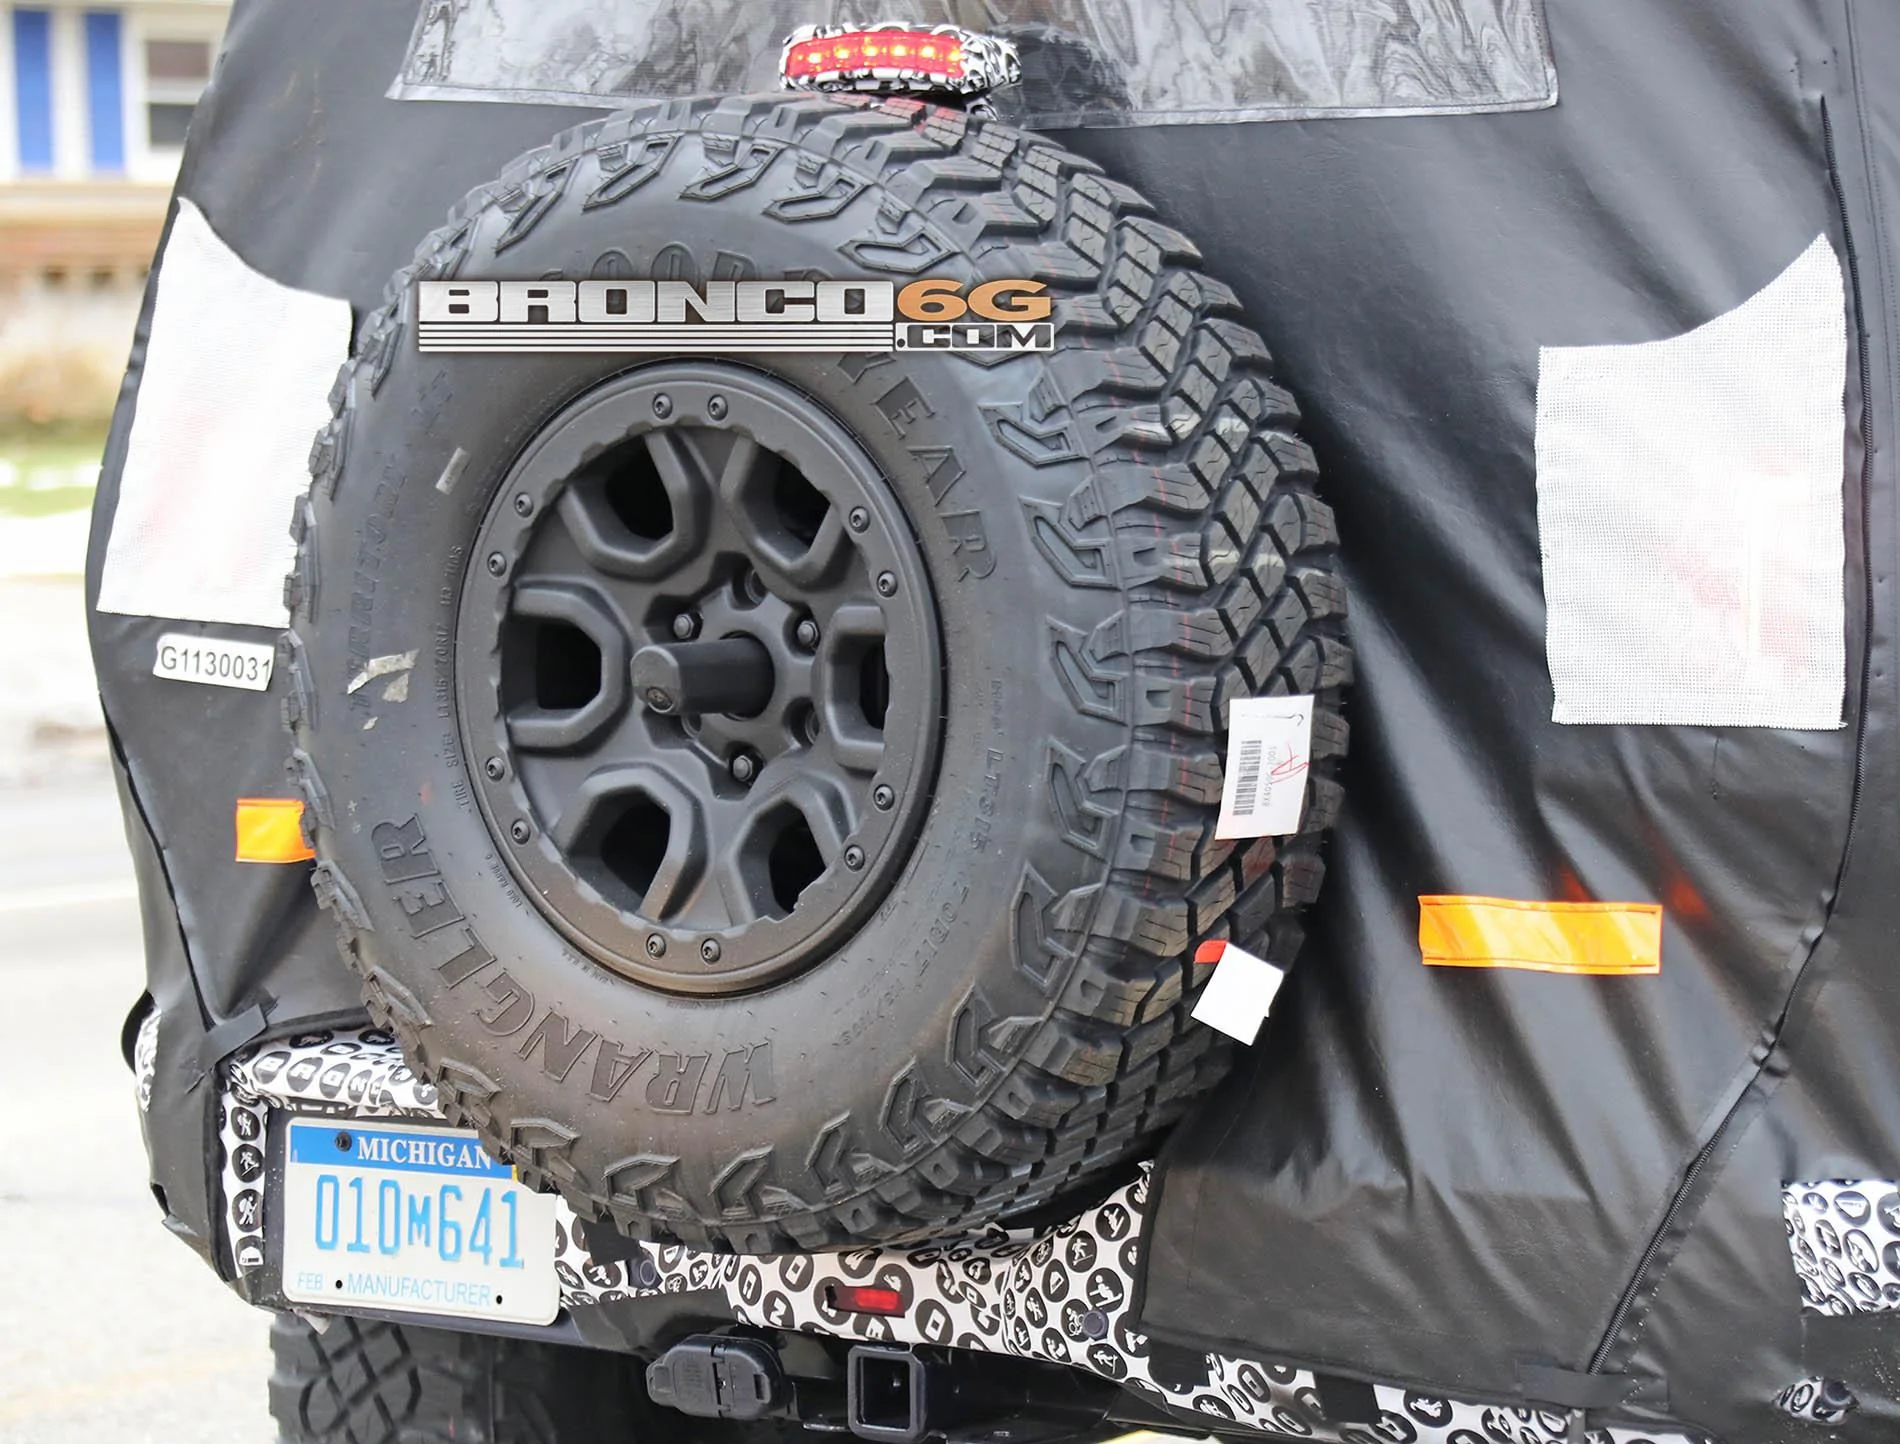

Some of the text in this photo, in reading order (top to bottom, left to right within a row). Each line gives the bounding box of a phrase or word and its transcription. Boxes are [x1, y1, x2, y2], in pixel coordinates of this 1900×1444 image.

[160, 645, 272, 682] G1130031
[370, 812, 778, 1116] WRANGLER
[357, 1136, 492, 1170] MICHIGAN
[315, 1174, 525, 1269] 010M641
[297, 1272, 492, 1308] FEB MANUFACTURER
